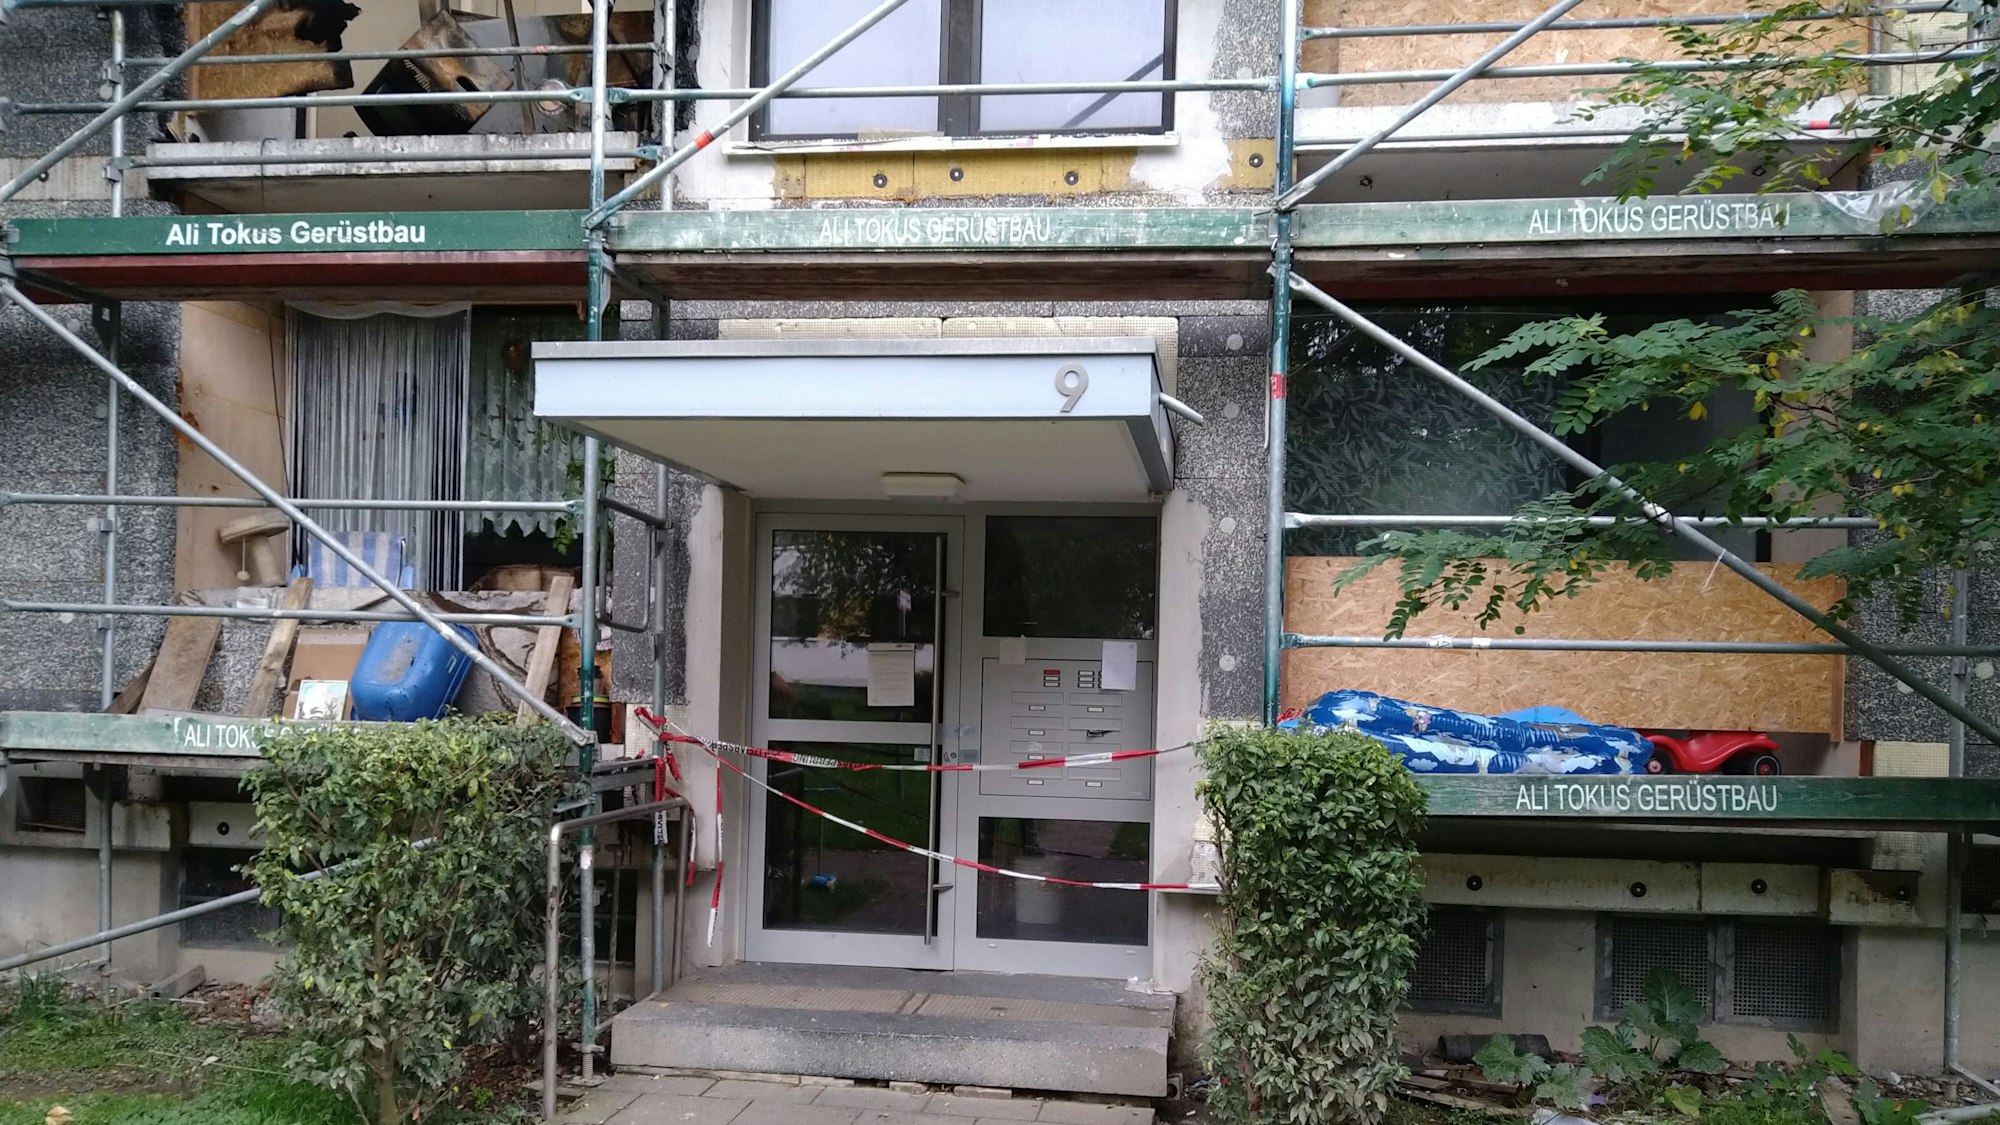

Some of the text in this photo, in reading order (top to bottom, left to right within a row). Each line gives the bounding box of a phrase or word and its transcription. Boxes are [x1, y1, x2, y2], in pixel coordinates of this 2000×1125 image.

[818, 213, 1051, 244] ALI TOKUS GERÜSTBAU
[1529, 200, 1790, 234] ALI TOKUS GERÜSTBAU
[165, 220, 425, 246] Ali Tokus Gerüstbau
[1055, 361, 1089, 413] 9
[184, 724, 210, 747] ALI
[215, 724, 274, 749] TOK
[1516, 780, 1777, 812] ALI TOKUS GERÜSTBAU
